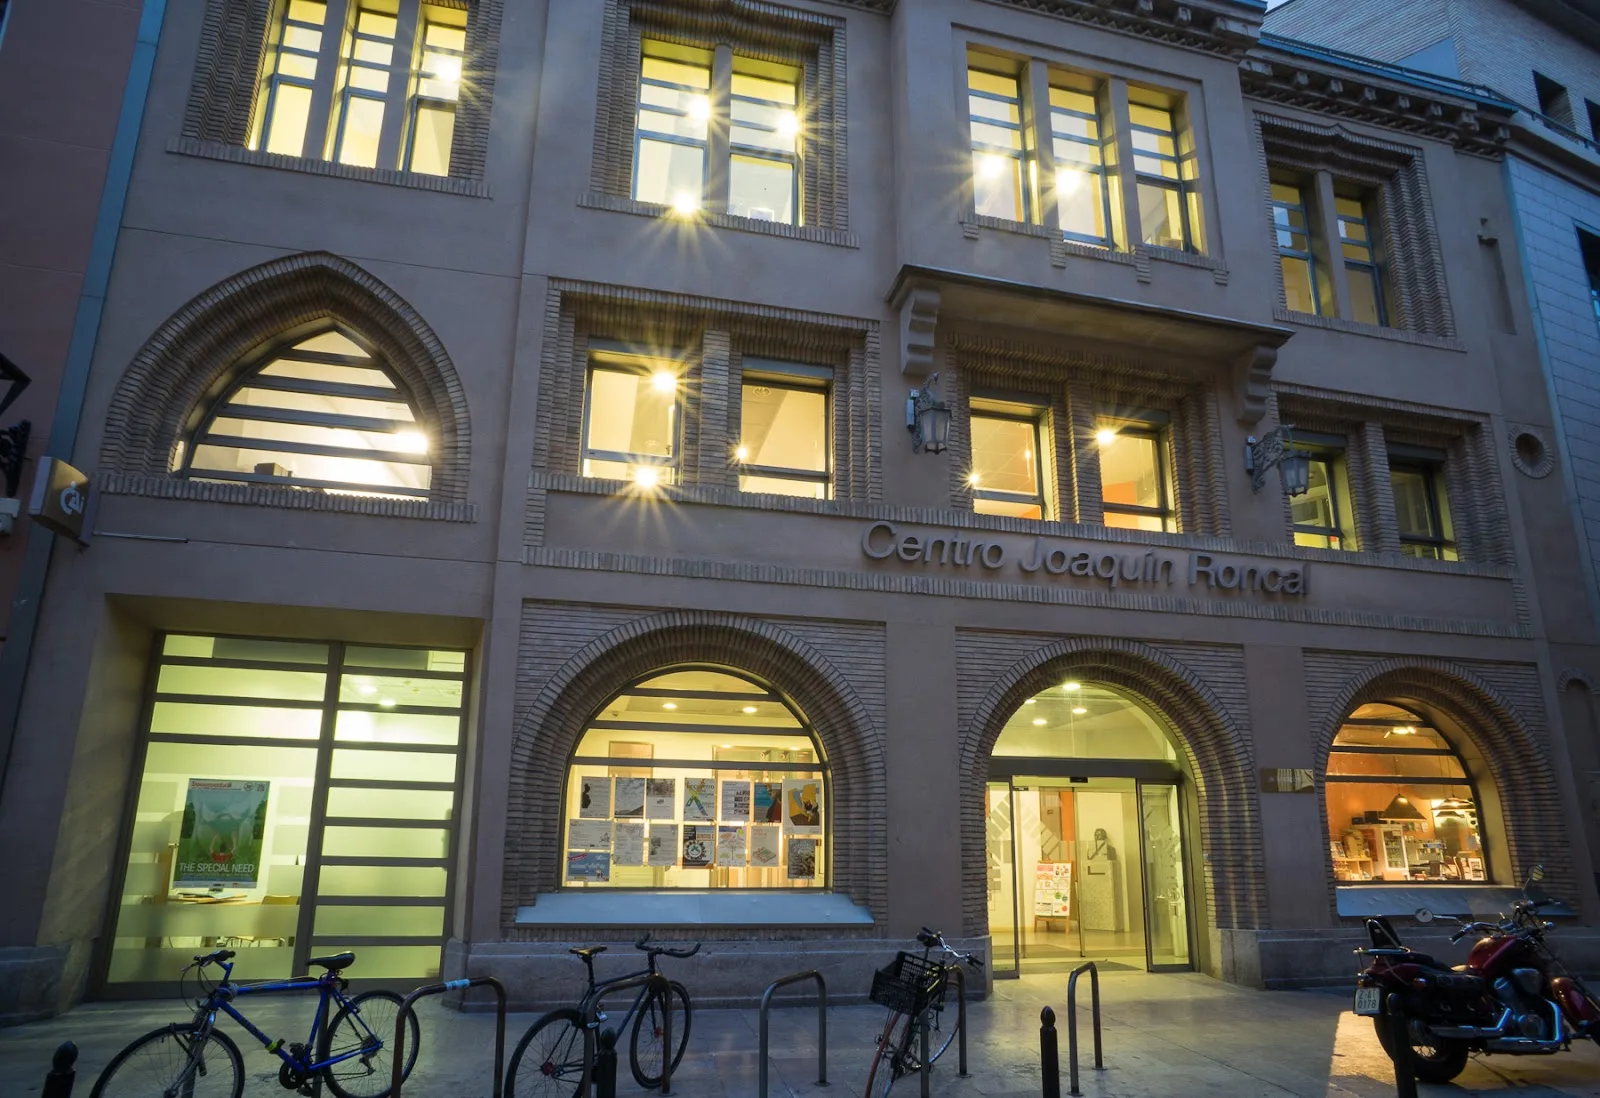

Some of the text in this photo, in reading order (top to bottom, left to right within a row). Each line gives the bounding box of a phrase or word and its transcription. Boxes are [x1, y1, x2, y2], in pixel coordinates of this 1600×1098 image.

[860, 520, 1310, 596] Centro Joaquín Roncal
[180, 862, 254, 873] THE SPECIAL NEED
[1357, 999, 1377, 1009] 0178
